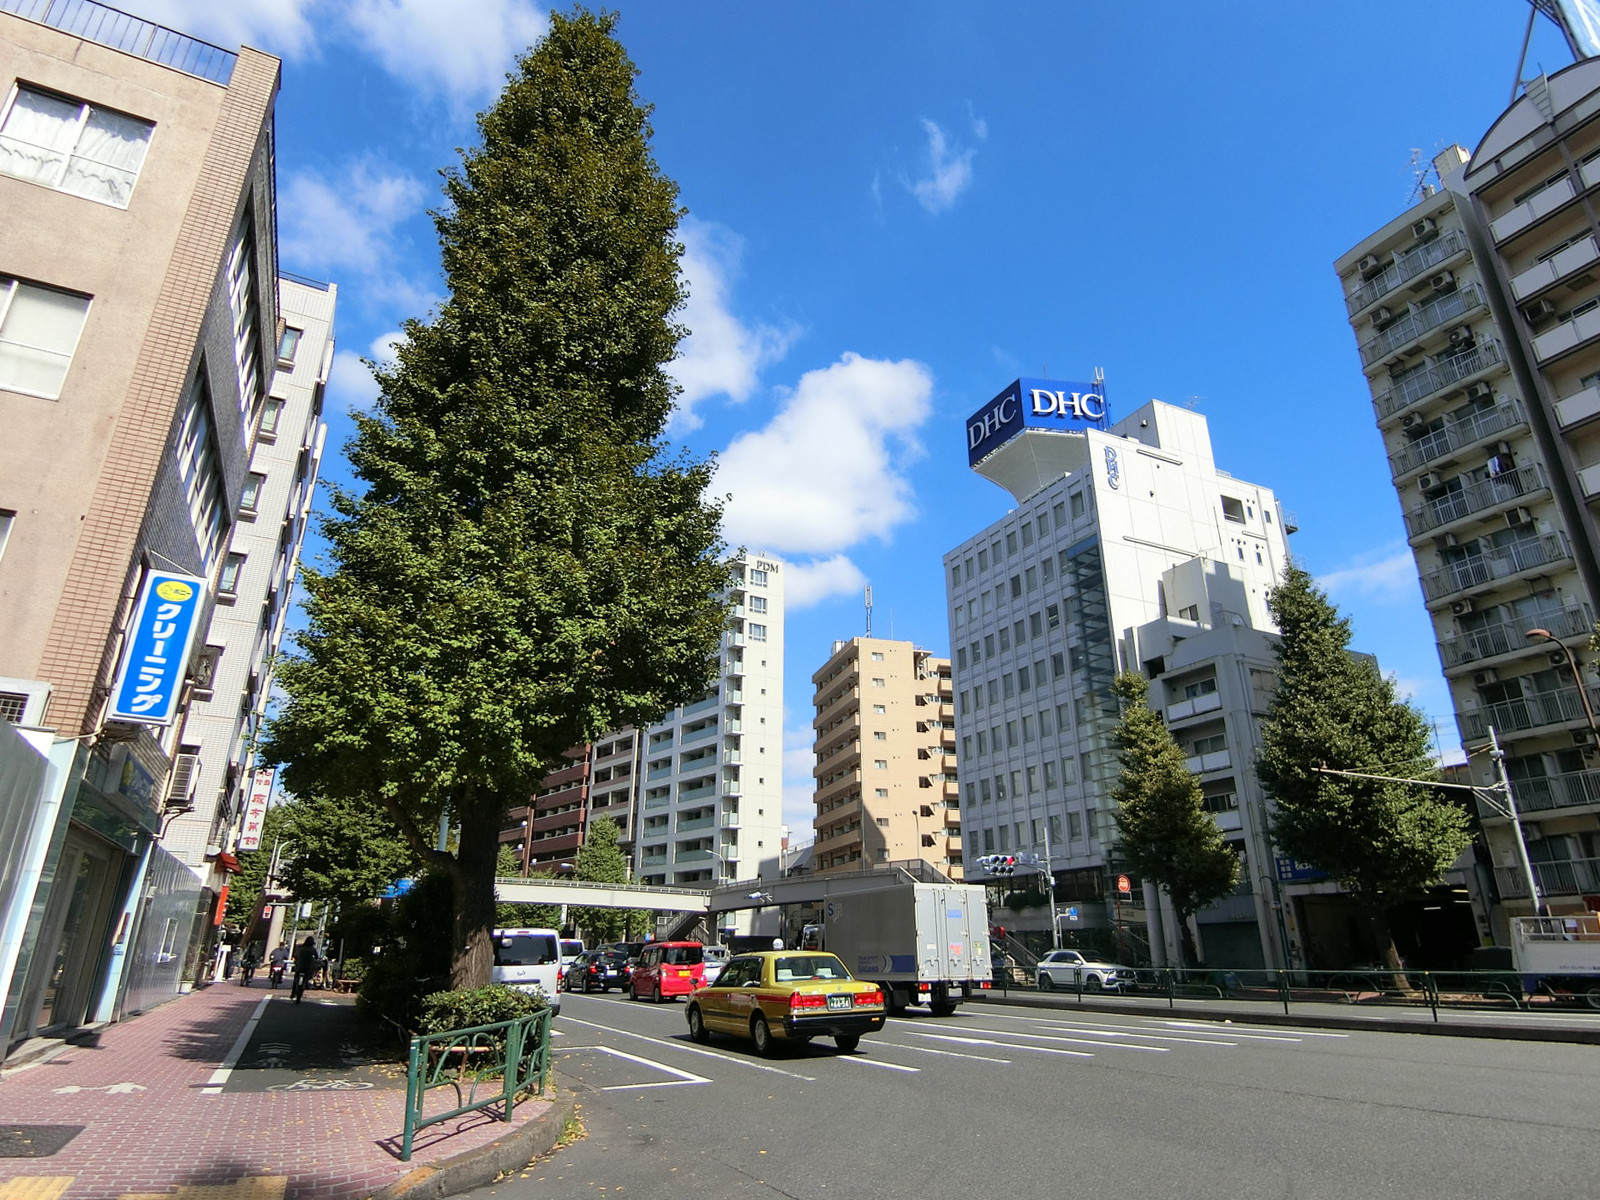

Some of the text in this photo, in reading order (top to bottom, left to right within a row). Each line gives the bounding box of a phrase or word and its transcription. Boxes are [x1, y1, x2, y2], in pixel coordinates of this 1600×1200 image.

[968, 394, 1016, 450] DHC
[1030, 389, 1105, 418] DHC
[1104, 446, 1120, 490] DHC
[756, 560, 779, 574] PDM
[130, 603, 182, 712] クリーニング
